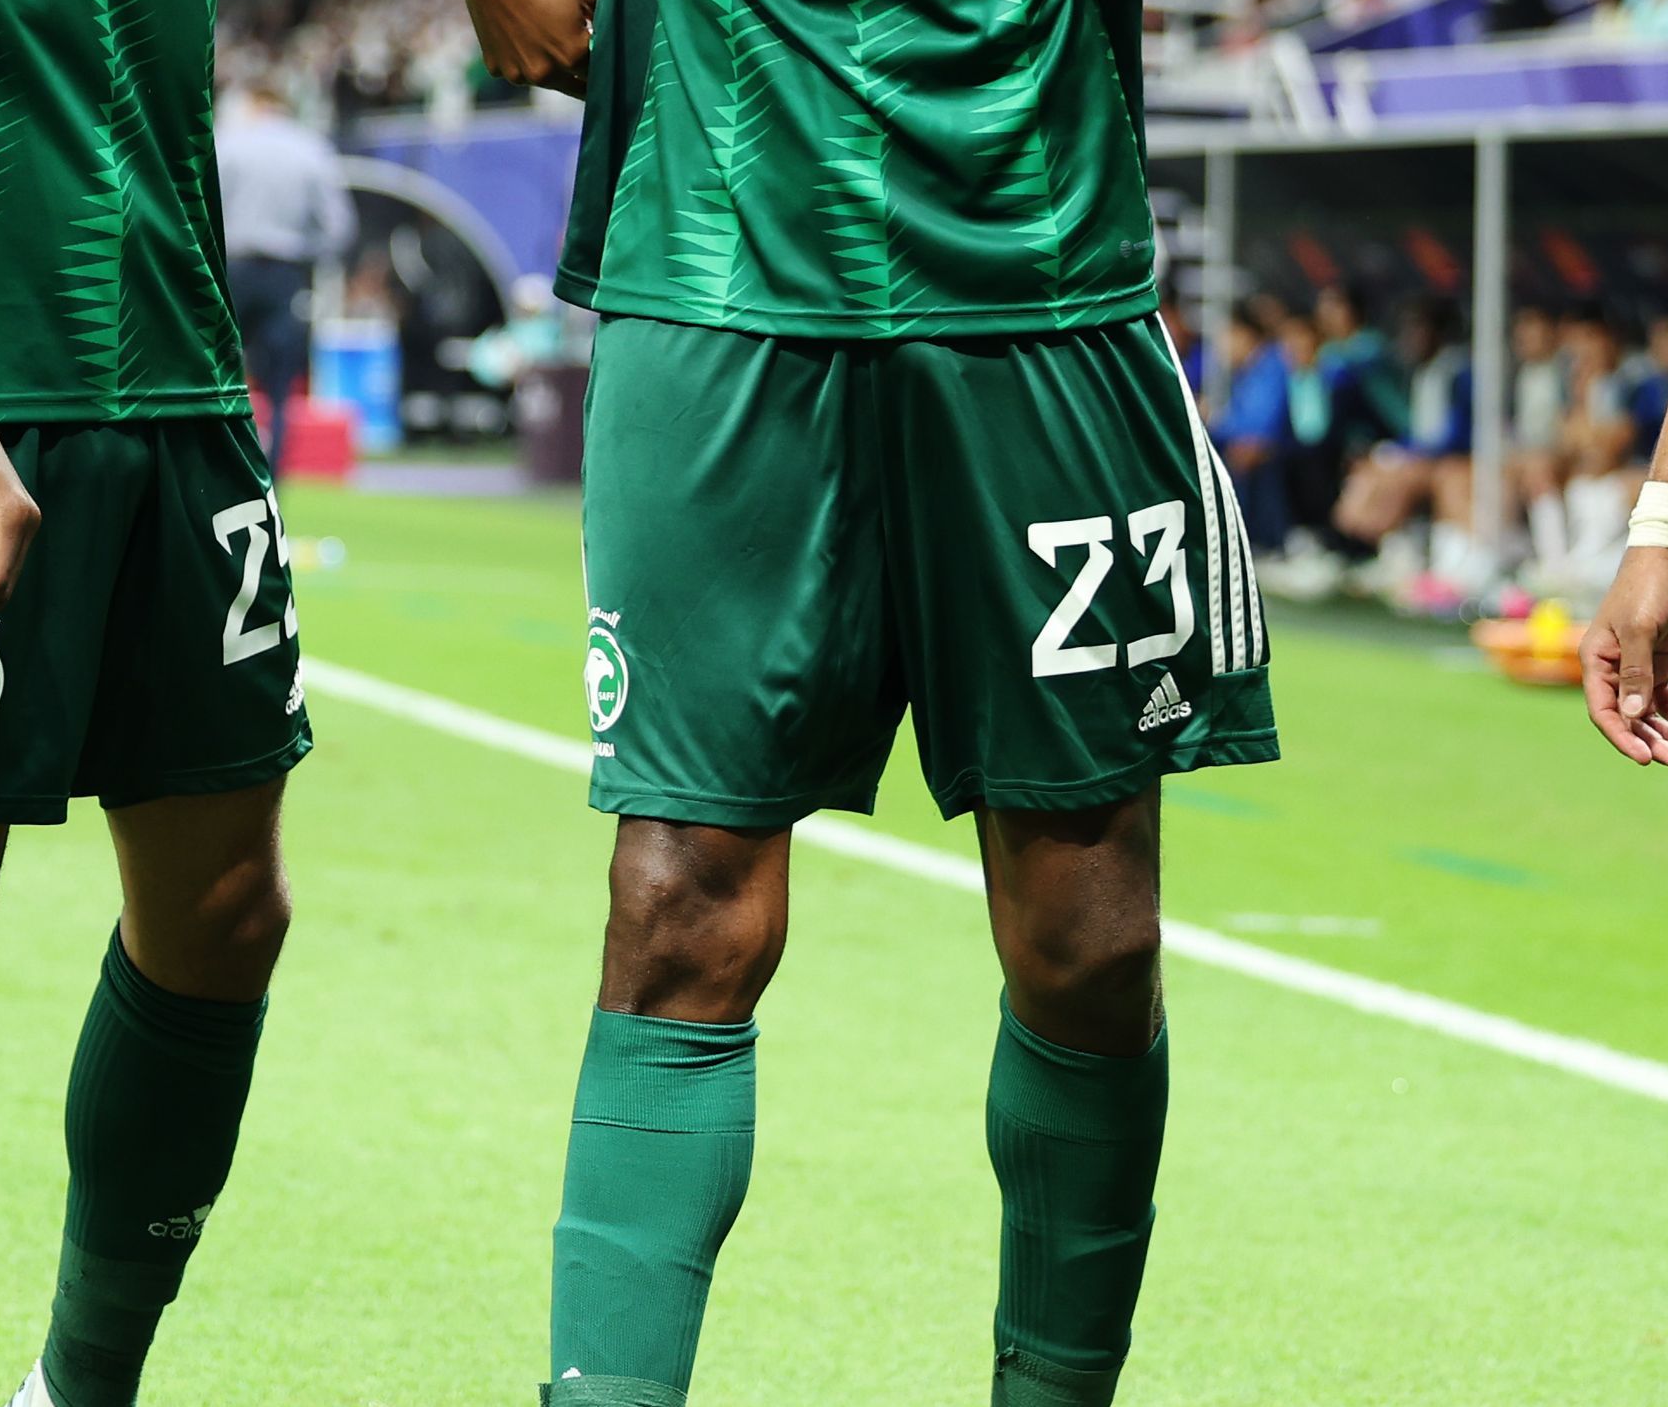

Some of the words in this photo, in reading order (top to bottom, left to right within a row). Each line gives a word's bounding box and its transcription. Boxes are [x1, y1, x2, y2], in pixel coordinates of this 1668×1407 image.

[1028, 500, 1194, 677] 23
[598, 691, 616, 702] SAFF
[1138, 701, 1192, 732] adidas
